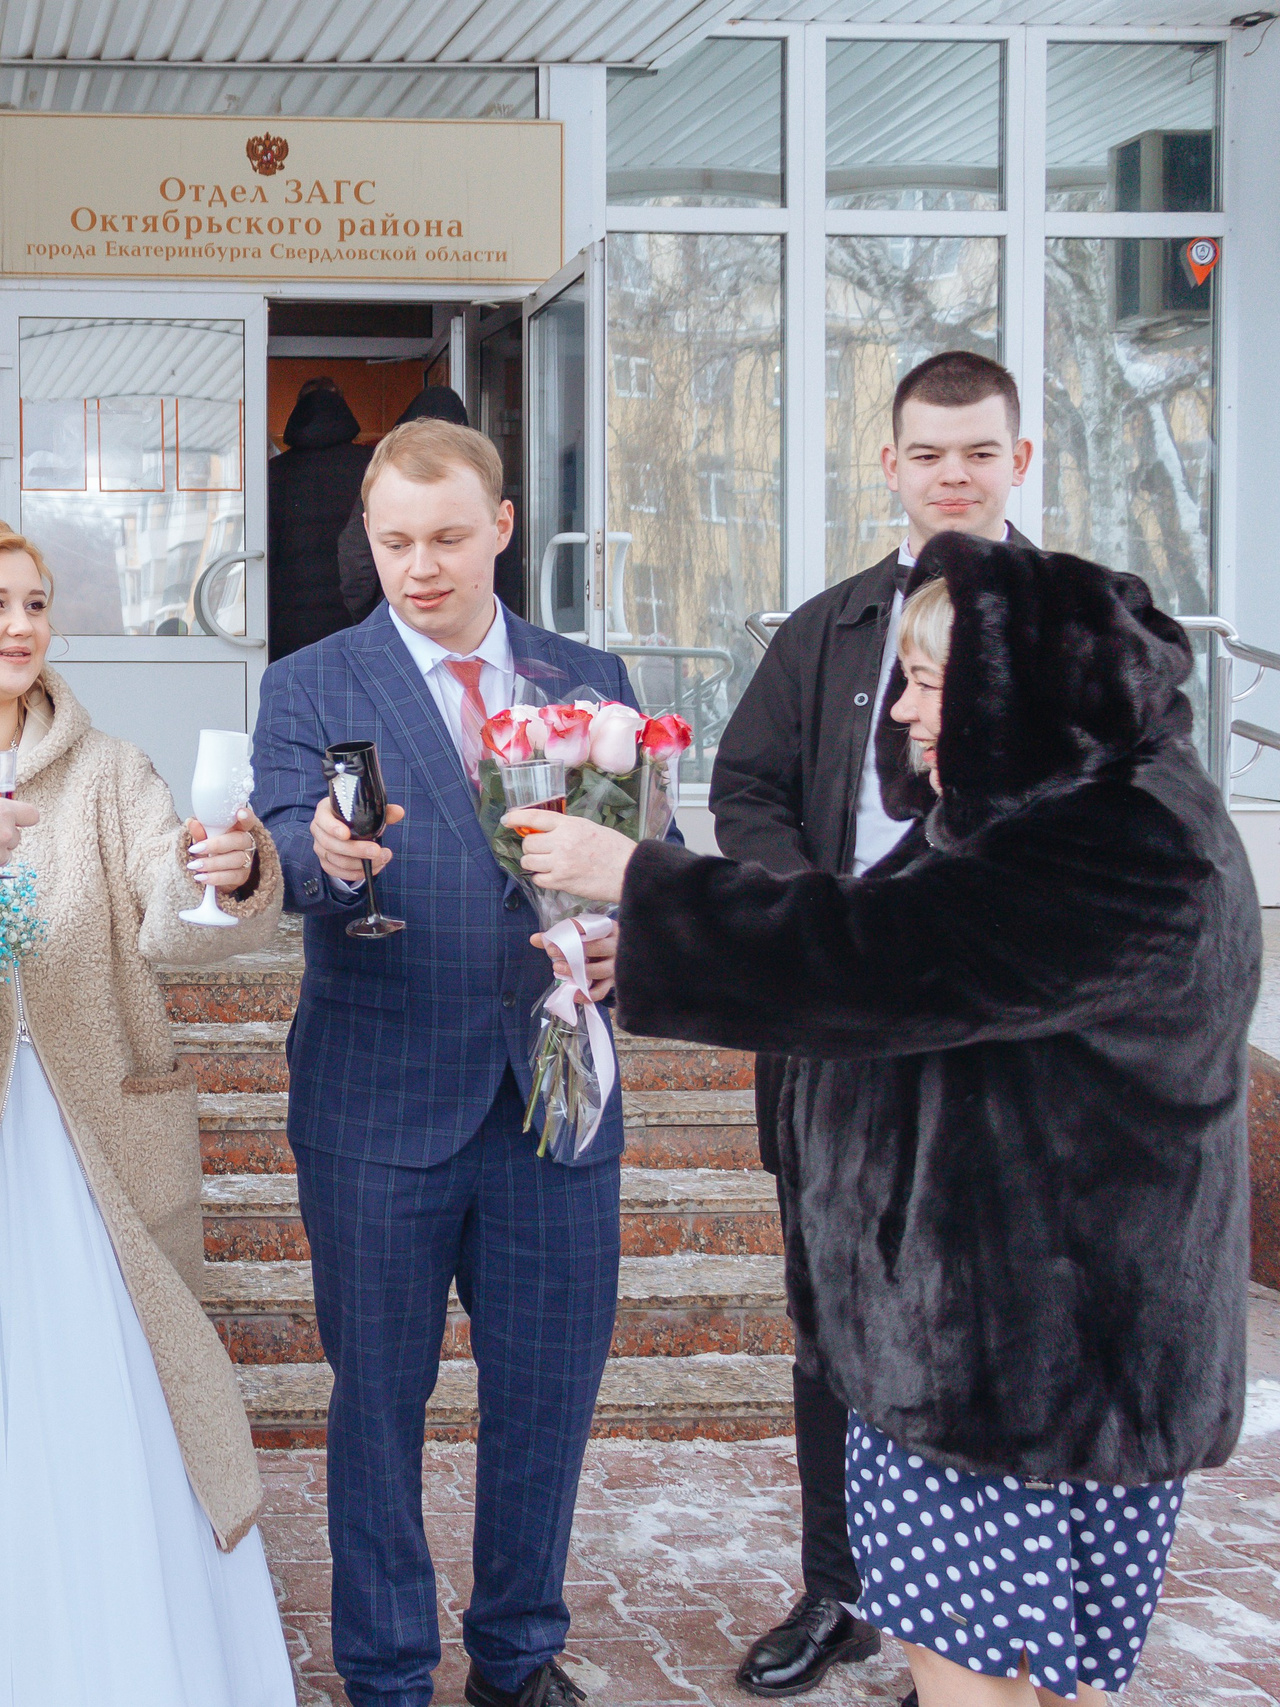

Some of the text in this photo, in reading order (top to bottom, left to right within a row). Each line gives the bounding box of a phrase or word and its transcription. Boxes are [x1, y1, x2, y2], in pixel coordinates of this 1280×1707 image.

[158, 177, 377, 207] Отдел ЗАГС
[70, 207, 463, 242] Октябрьского района
[26, 242, 508, 263] города Екатеринбурга Свердловской области
